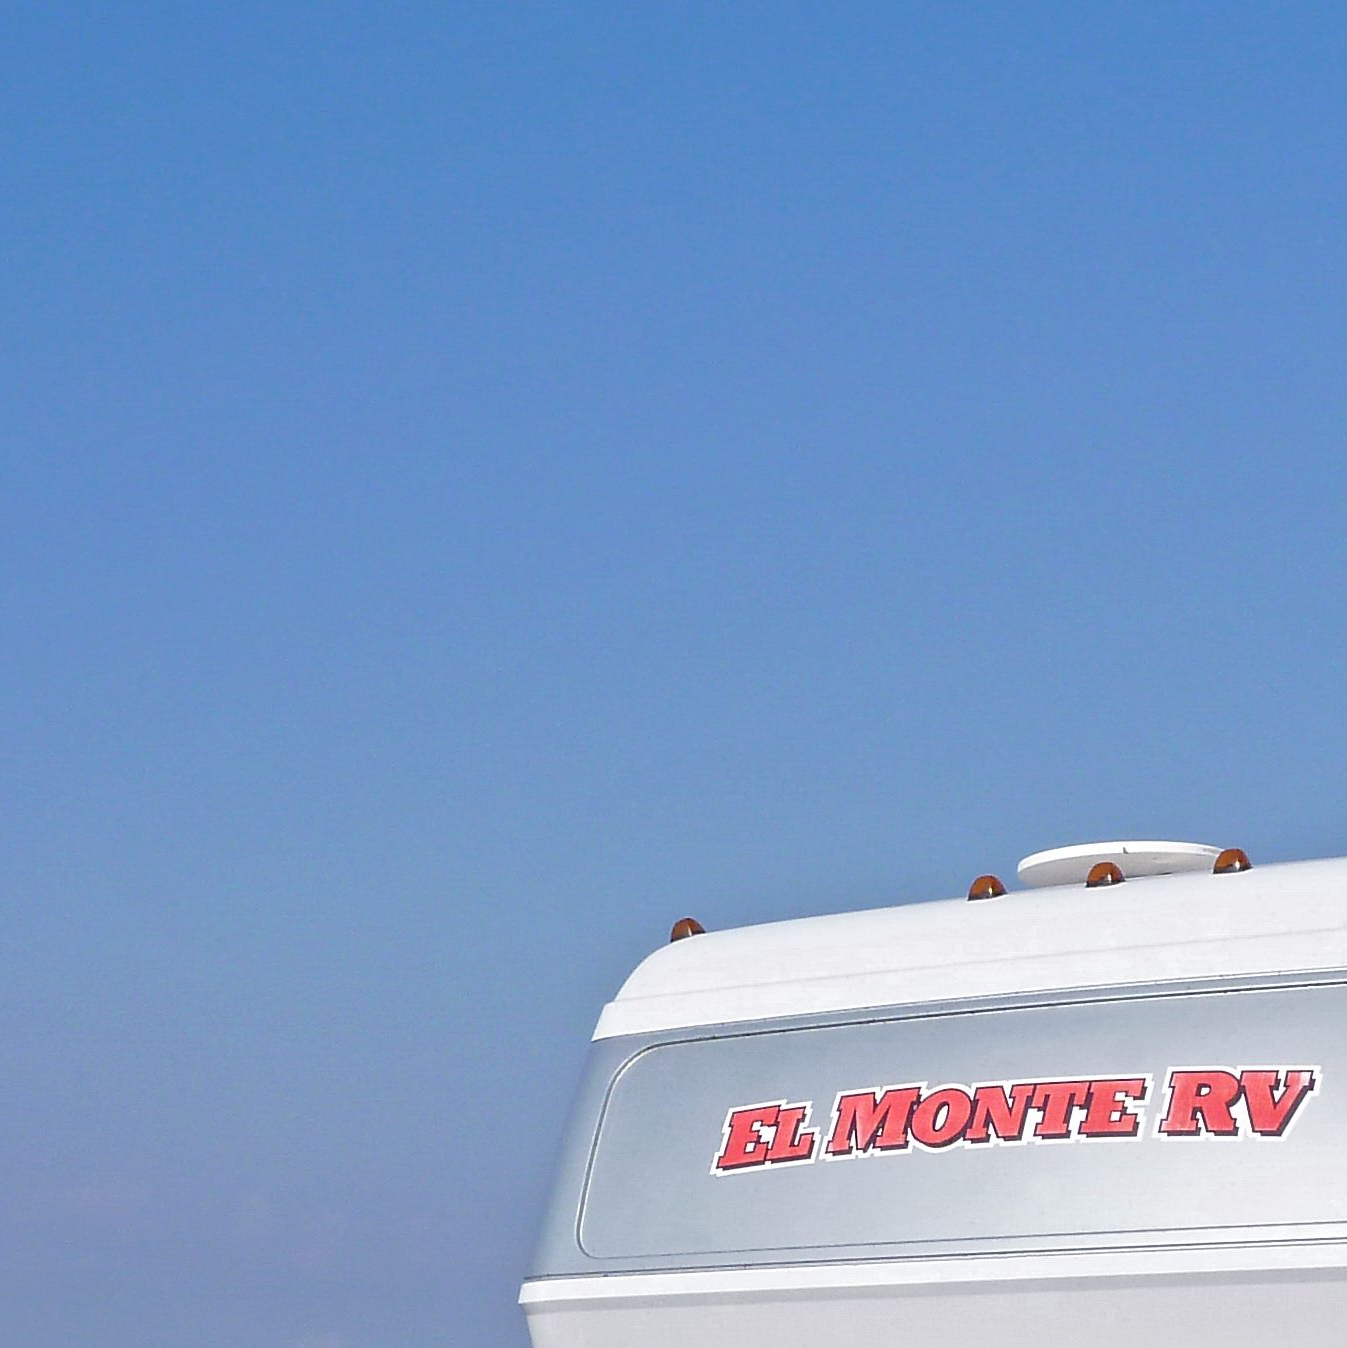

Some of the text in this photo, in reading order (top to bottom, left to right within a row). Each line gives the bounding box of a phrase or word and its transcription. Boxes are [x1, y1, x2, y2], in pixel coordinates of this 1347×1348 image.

[712, 1067, 1318, 1173] EL MONTE RV
